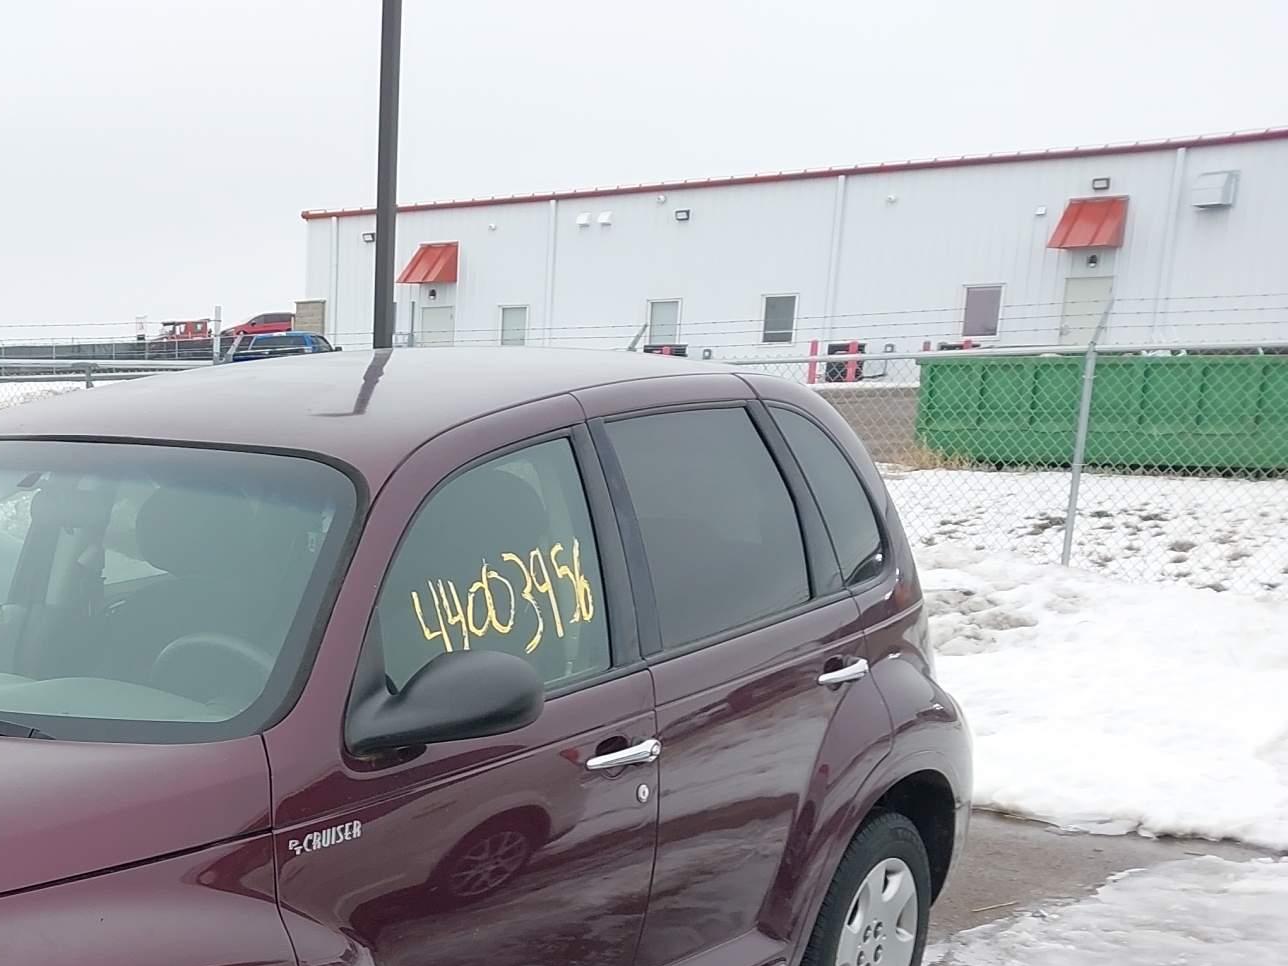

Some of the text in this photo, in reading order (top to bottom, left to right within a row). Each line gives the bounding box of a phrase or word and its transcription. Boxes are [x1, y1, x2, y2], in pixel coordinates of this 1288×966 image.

[411, 536, 594, 654] 44003956
[288, 820, 362, 856] PT CRUISER
